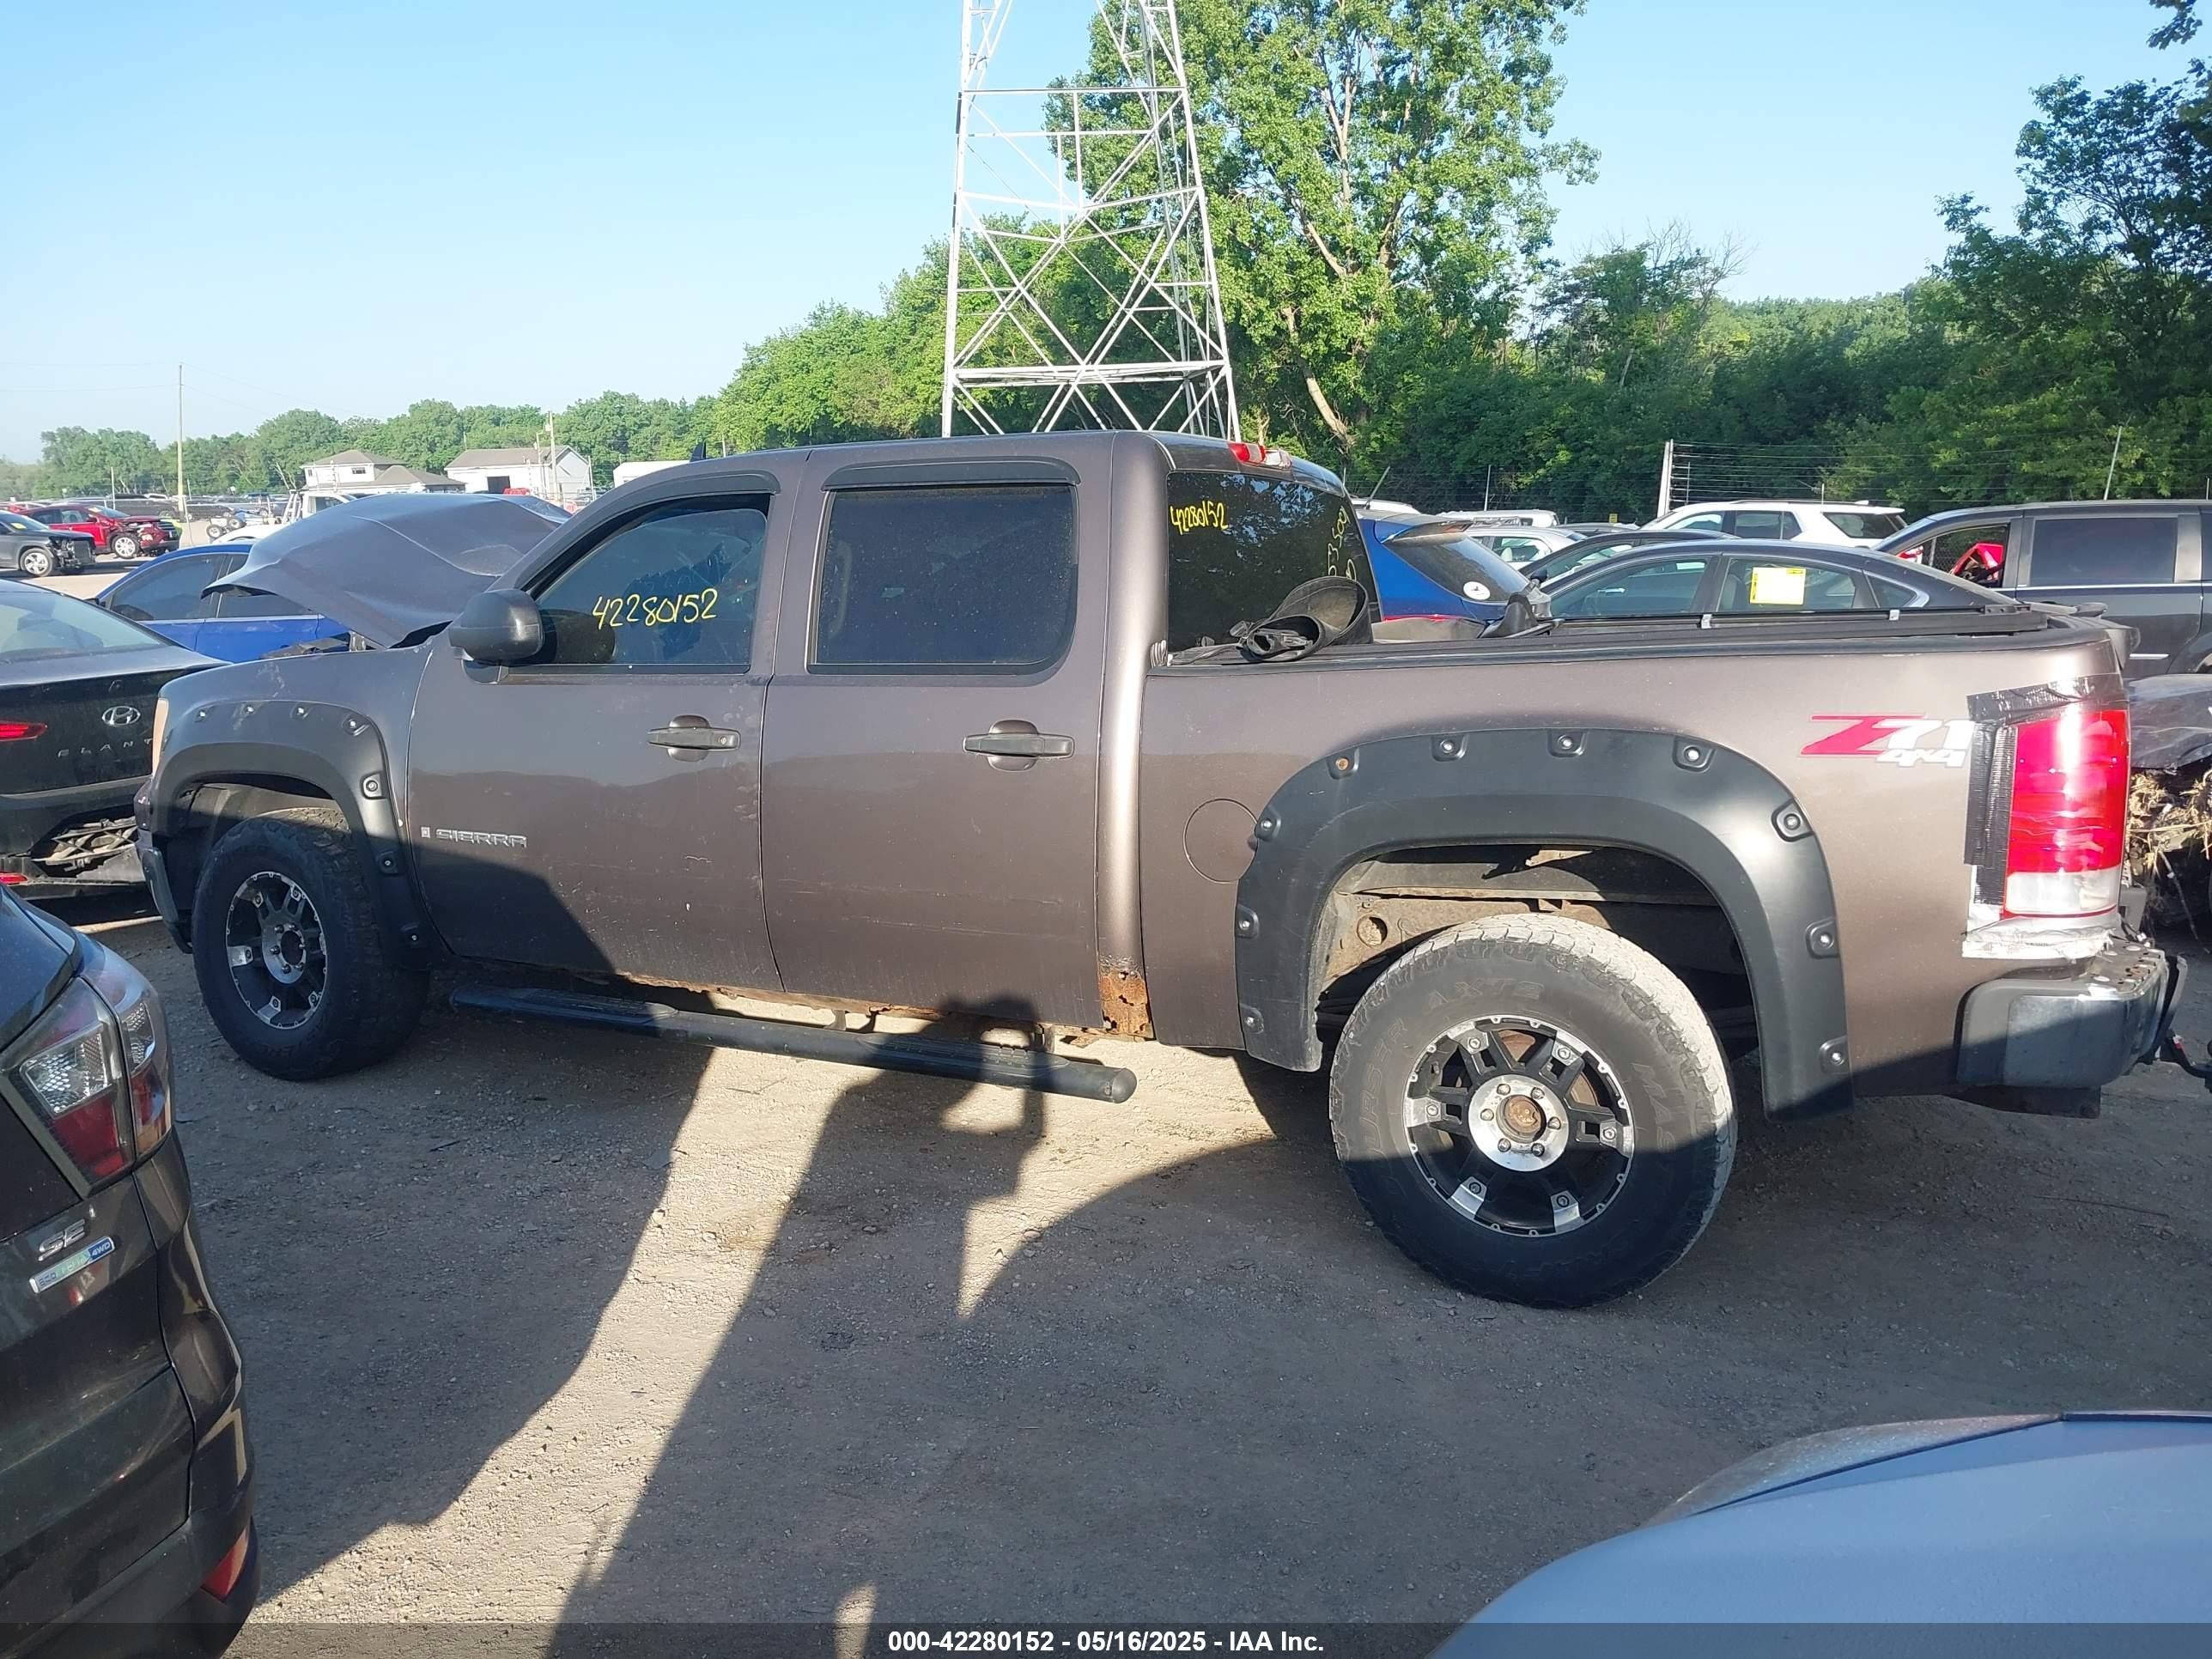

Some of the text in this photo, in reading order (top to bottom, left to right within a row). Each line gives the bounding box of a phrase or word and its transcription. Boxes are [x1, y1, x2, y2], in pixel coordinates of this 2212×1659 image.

[1170, 500, 1229, 536] 42280152
[592, 587, 718, 630] 42280152
[1799, 714, 1976, 757] Z71
[435, 828, 528, 849] SIERRA
[38, 1218, 86, 1261] SE
[91, 1241, 111, 1257] 4WD
